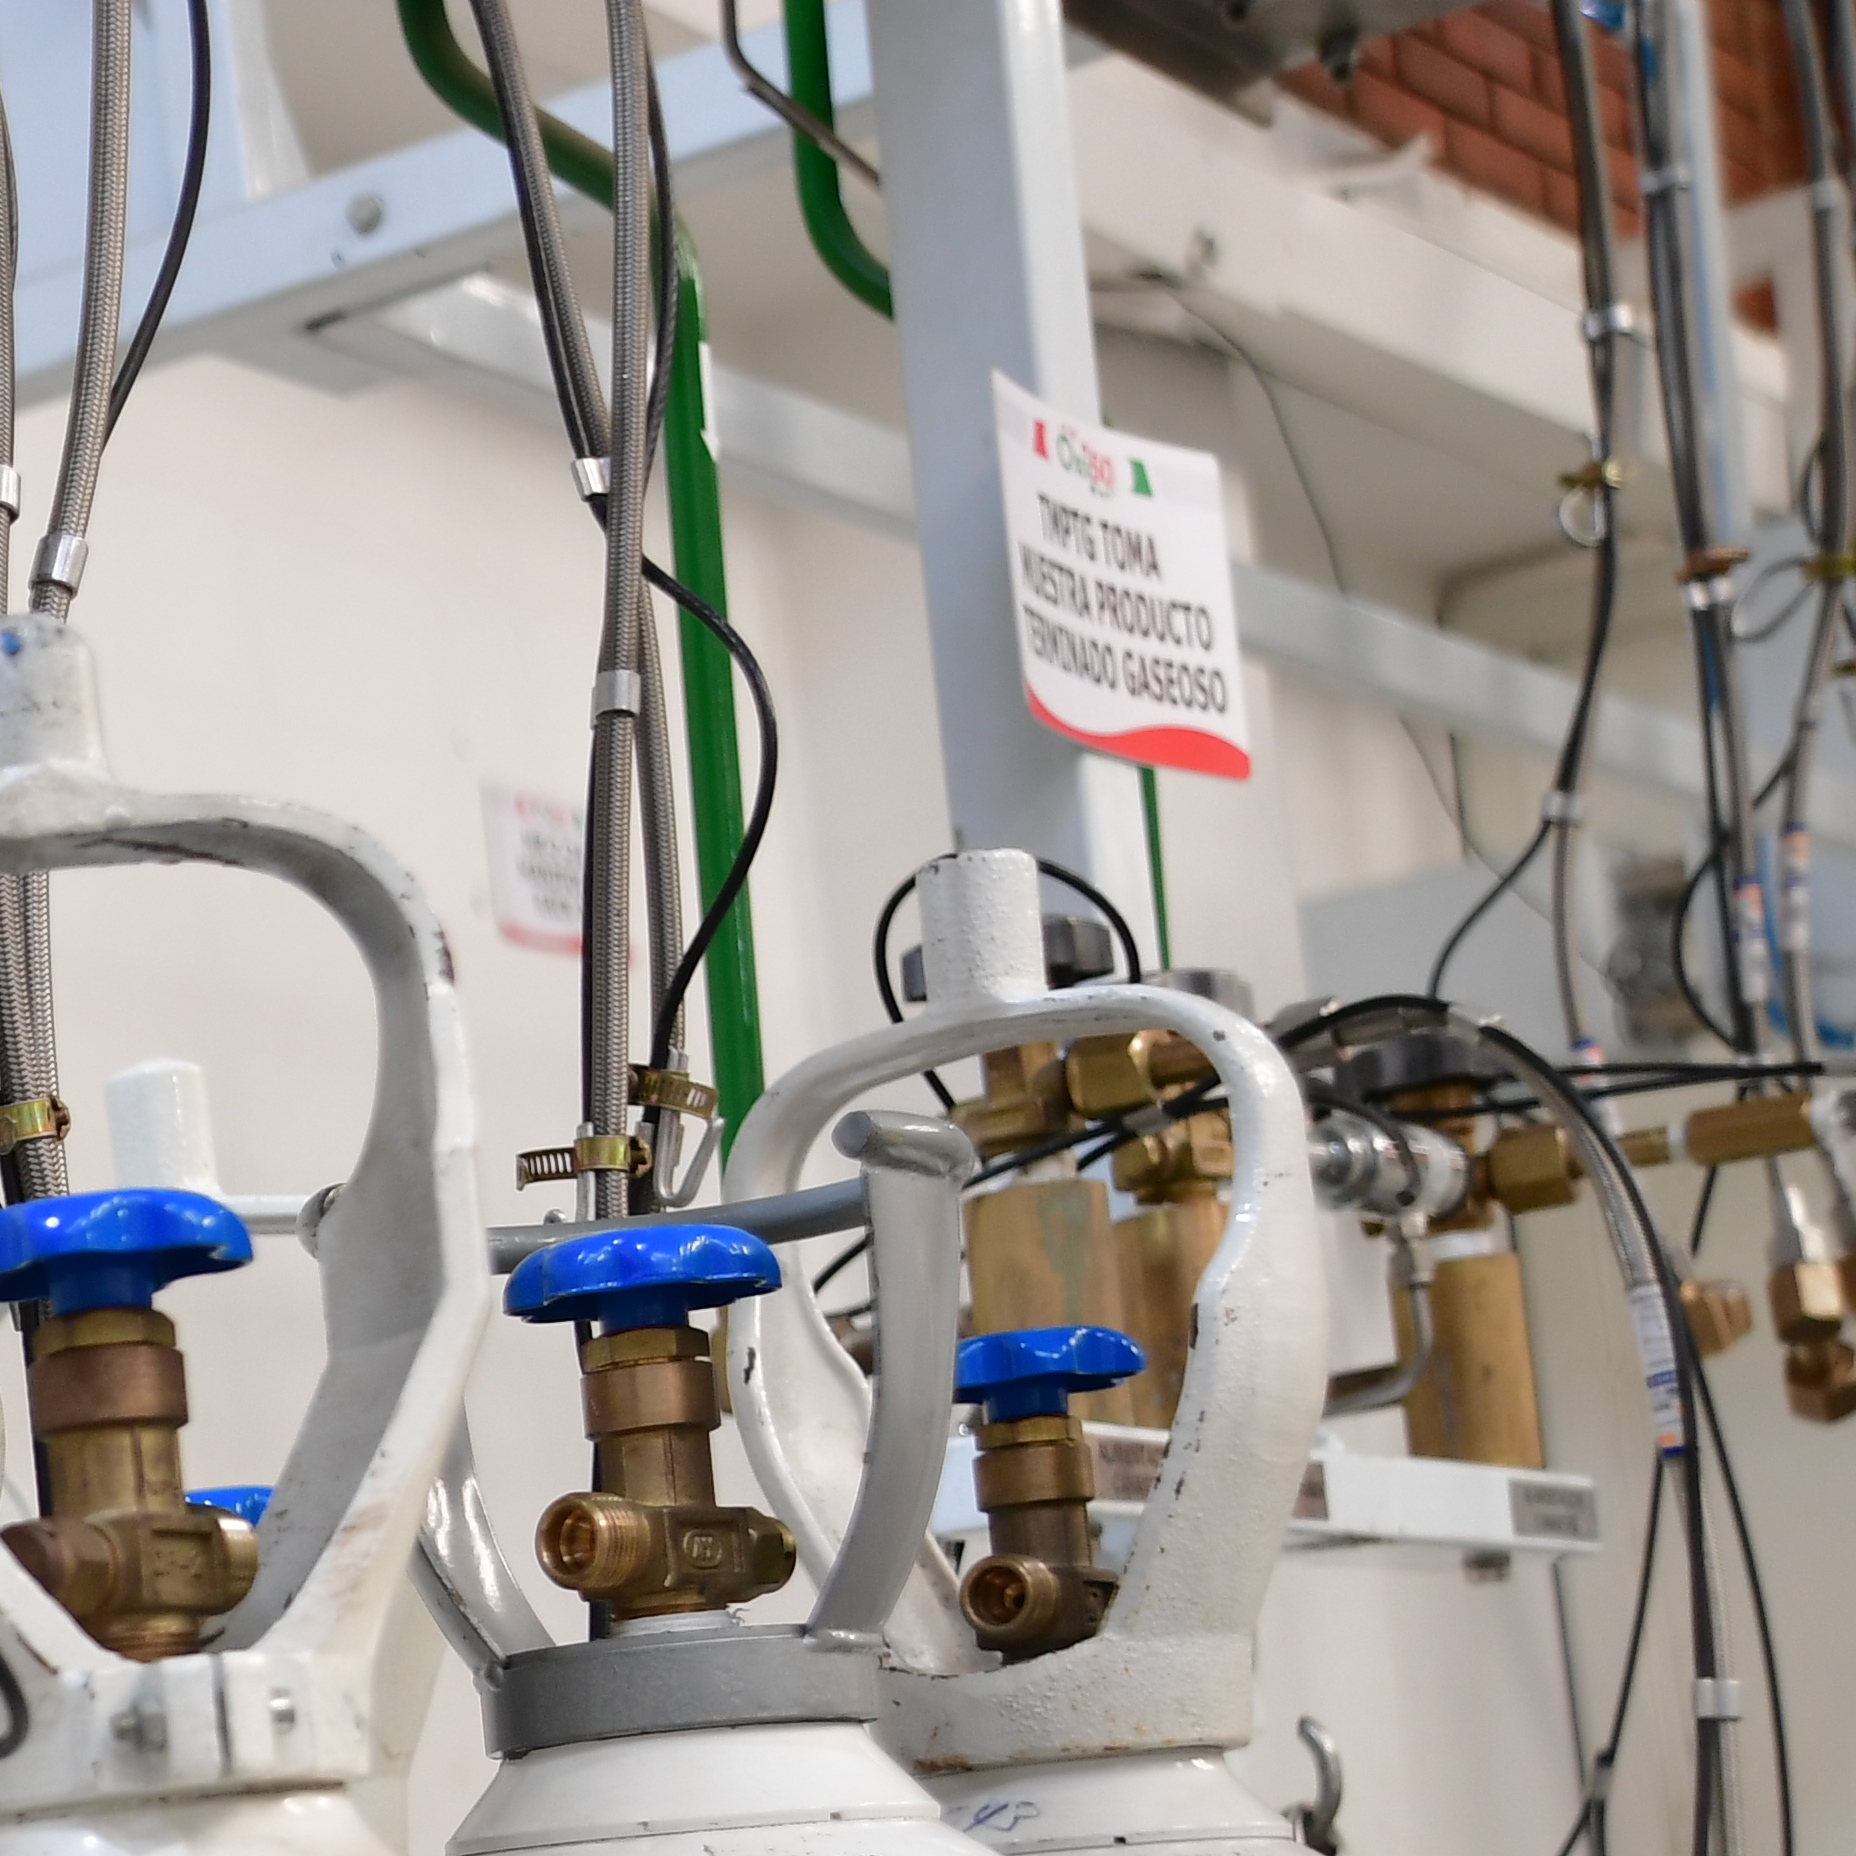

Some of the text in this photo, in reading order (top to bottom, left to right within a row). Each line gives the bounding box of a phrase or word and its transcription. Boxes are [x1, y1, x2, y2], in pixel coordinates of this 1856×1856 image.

[1099, 522, 1161, 581] TOMA
[1095, 579, 1213, 652] PRODUCTO
[1022, 603, 1227, 715] TERMINADO GASEOSO
